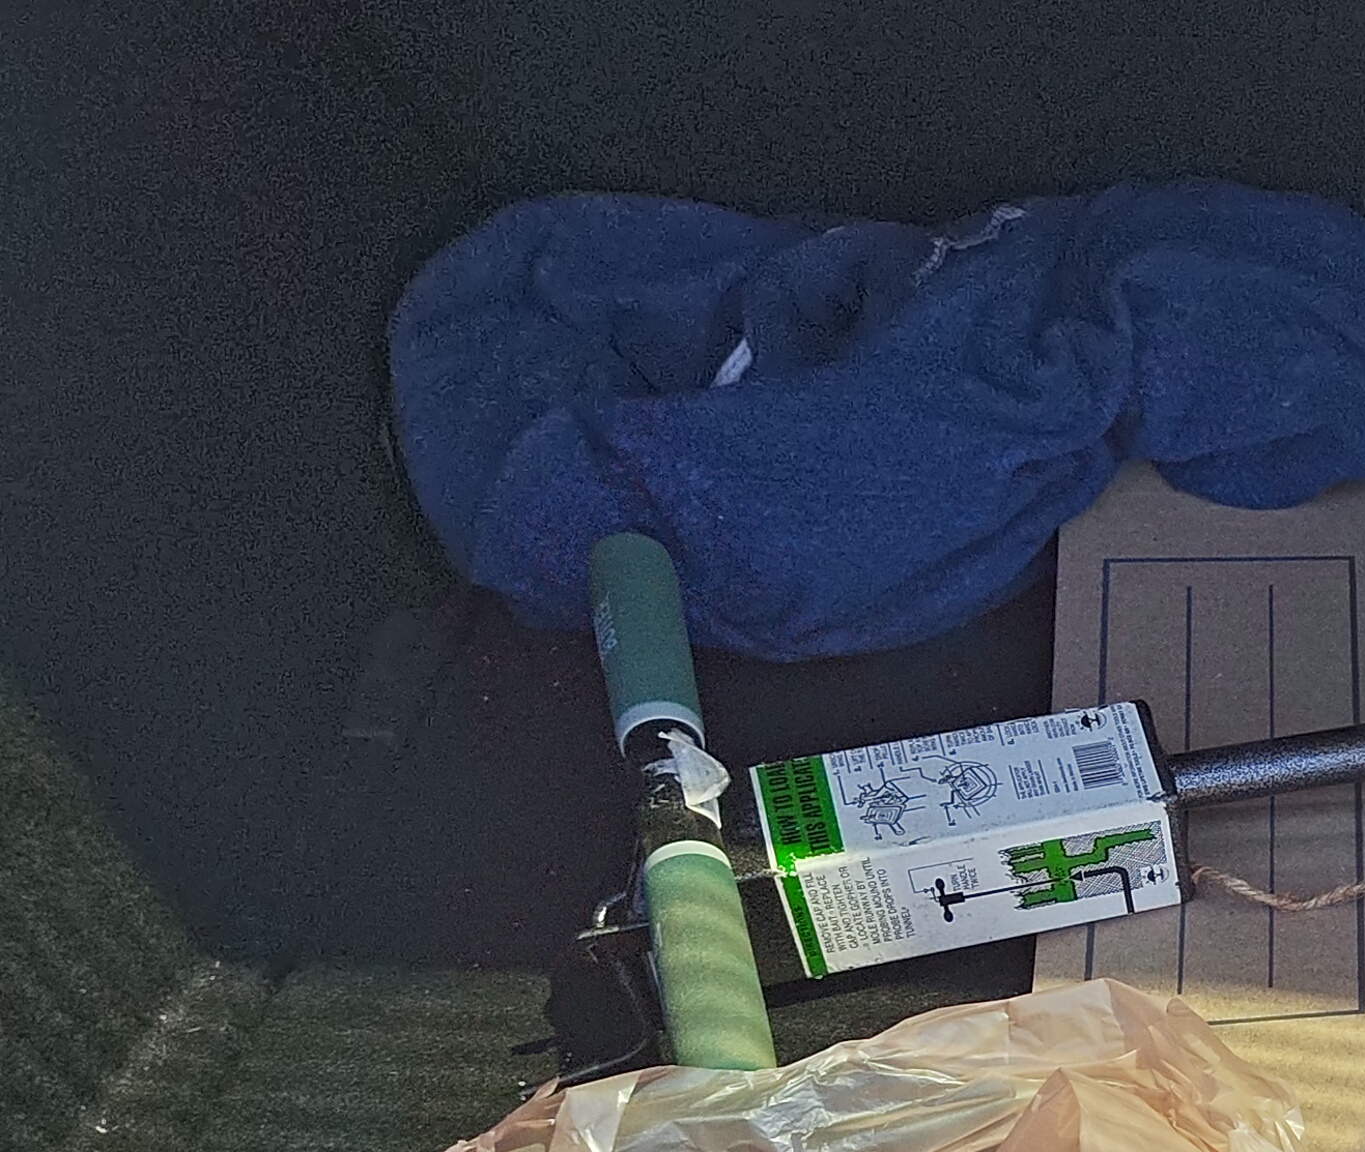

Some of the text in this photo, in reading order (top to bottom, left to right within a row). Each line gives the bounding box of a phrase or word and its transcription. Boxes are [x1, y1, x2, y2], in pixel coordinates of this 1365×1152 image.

[771, 793, 795, 812] TO
[775, 812, 802, 845] HOW
[788, 757, 832, 853] THIS APPLICAT
[838, 865, 868, 940] LOCATE GOPHER OR
[860, 856, 893, 942] PROBING MOUND UNTIL
[876, 867, 904, 940] PROBE DROPS INTO
[949, 873, 961, 891] TURN
[956, 864, 970, 890] HANDLE
[967, 867, 979, 888] TWICE
[792, 905, 817, 957] DIRECTIONS
[801, 872, 835, 953] REMOVE CAP AND FILL
[816, 874, 847, 951] WITH BAIT REPLACE
[831, 883, 859, 949] CAP AND TIGHTEN
[854, 878, 881, 944] MOLE RUNWAY BY
